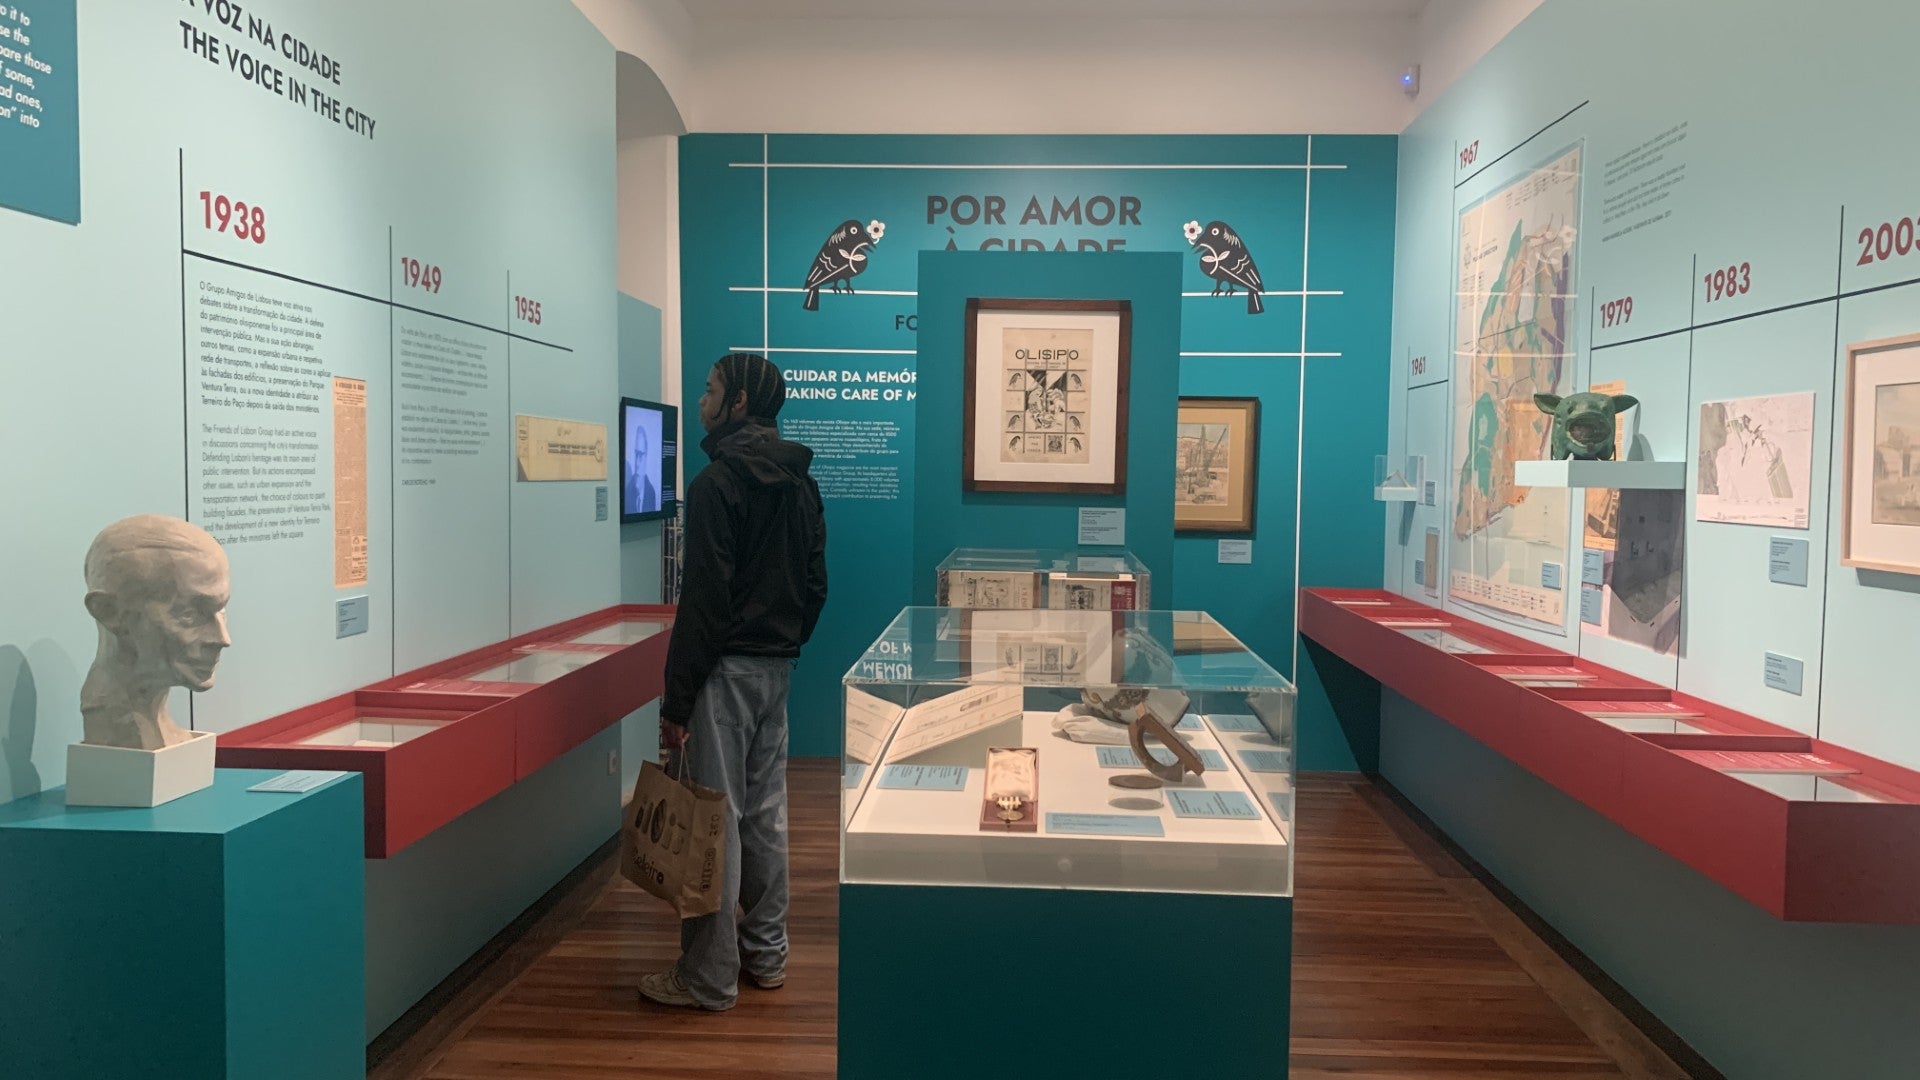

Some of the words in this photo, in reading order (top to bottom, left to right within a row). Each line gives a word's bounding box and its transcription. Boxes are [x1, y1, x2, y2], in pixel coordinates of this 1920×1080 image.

[10, 6, 17, 20] it
[20, 11, 30, 26] to
[13, 27, 30, 46] the
[249, 13, 275, 50] NA
[282, 33, 341, 85] CIDADE
[24, 52, 52, 74] those
[5, 68, 35, 90] some,
[180, 20, 219, 65] THE
[226, 44, 283, 95] VOICE
[289, 77, 306, 107] IN
[311, 87, 340, 124] THE
[345, 107, 376, 140] CITY
[15, 92, 43, 112] ones,
[20, 109, 39, 128] into
[1460, 140, 1479, 170] 1967
[200, 191, 266, 244] 1938
[927, 195, 1006, 225] POR
[1019, 195, 1142, 225] AMOR
[401, 257, 442, 294] 1949
[1704, 262, 1751, 302] 1983
[207, 283, 224, 295] Grupo
[226, 287, 245, 300] Amigos
[247, 292, 254, 300] de
[256, 294, 272, 305] Lisboa
[200, 296, 221, 308] debates
[223, 301, 238, 311] sobre
[244, 306, 278, 319] transformação
[200, 310, 208, 319] do
[515, 296, 541, 325] 1955
[1600, 296, 1633, 329] 1979
[201, 326, 232, 338] intervenção
[201, 341, 218, 349] outros
[238, 346, 252, 354] como
[1015, 349, 1079, 360] OLISIPO
[201, 354, 214, 362] rede
[215, 355, 222, 364] de
[1411, 357, 1426, 376] 1961
[209, 368, 232, 379] fachadas
[234, 372, 243, 380] dos
[783, 369, 837, 382] CUIDAR
[841, 371, 861, 382] DA
[202, 382, 222, 391] Ventura
[785, 387, 837, 400] TAKING
[841, 388, 879, 400] CARE
[883, 389, 902, 401] OF
[202, 395, 222, 406] Terreiro
[224, 398, 232, 406] do
[233, 398, 245, 409] Paço
[214, 425, 232, 434] Friends
[202, 452, 230, 464] Defending
